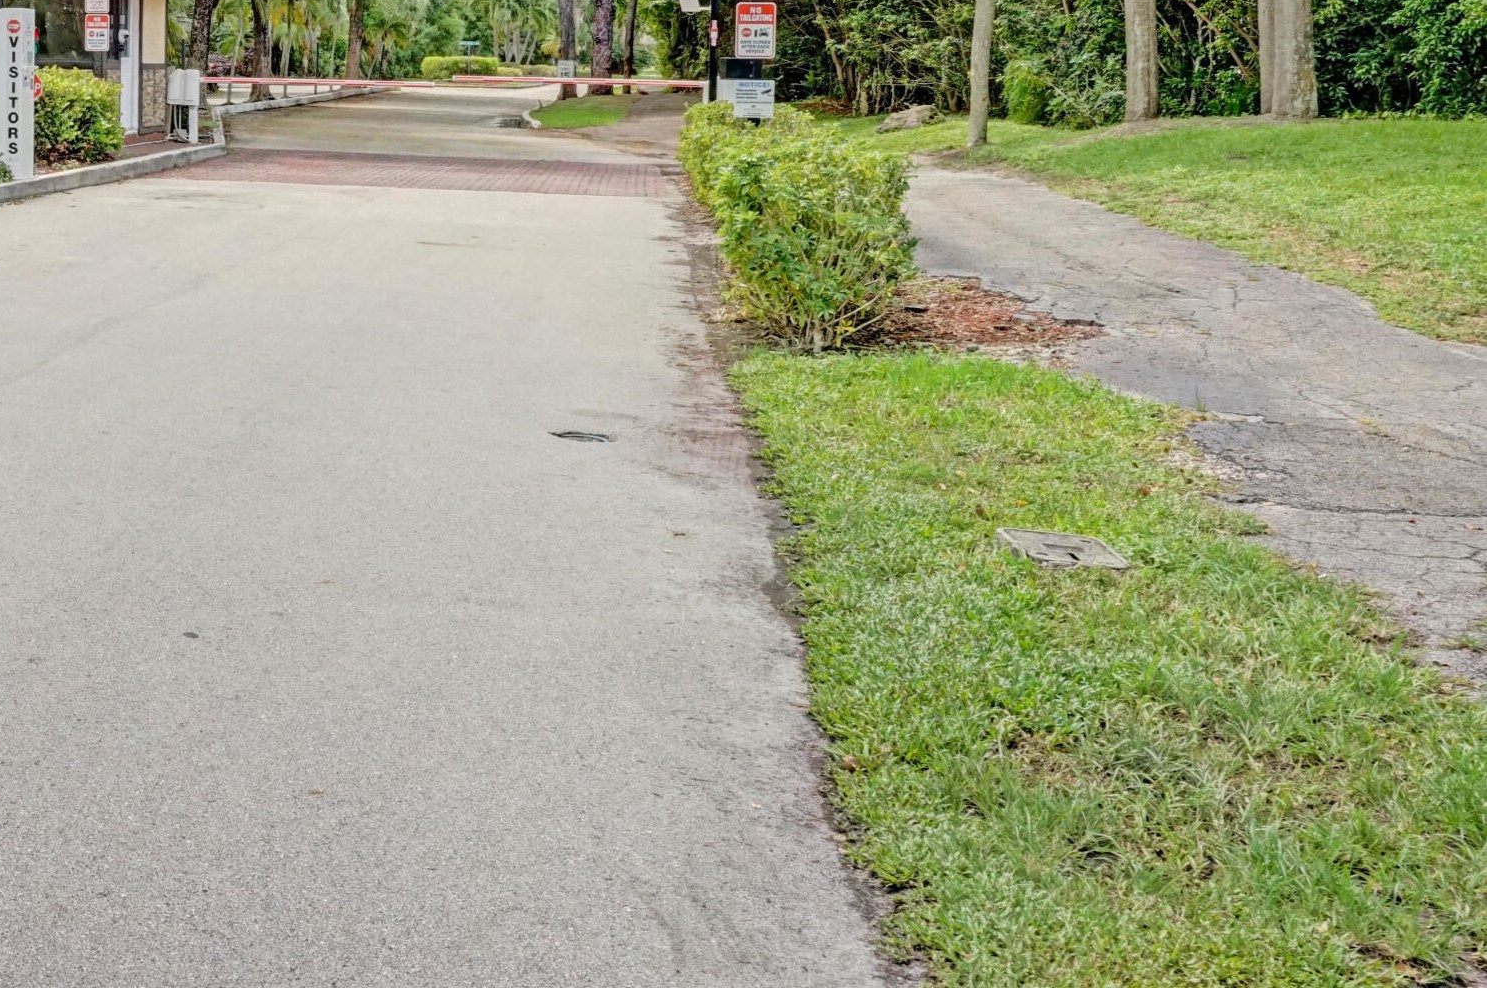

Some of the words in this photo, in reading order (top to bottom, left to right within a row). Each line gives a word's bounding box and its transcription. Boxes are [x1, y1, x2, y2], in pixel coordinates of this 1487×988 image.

[749, 6, 762, 14] NO
[739, 13, 773, 22] TAILGATING
[8, 36, 19, 154] VISITORS
